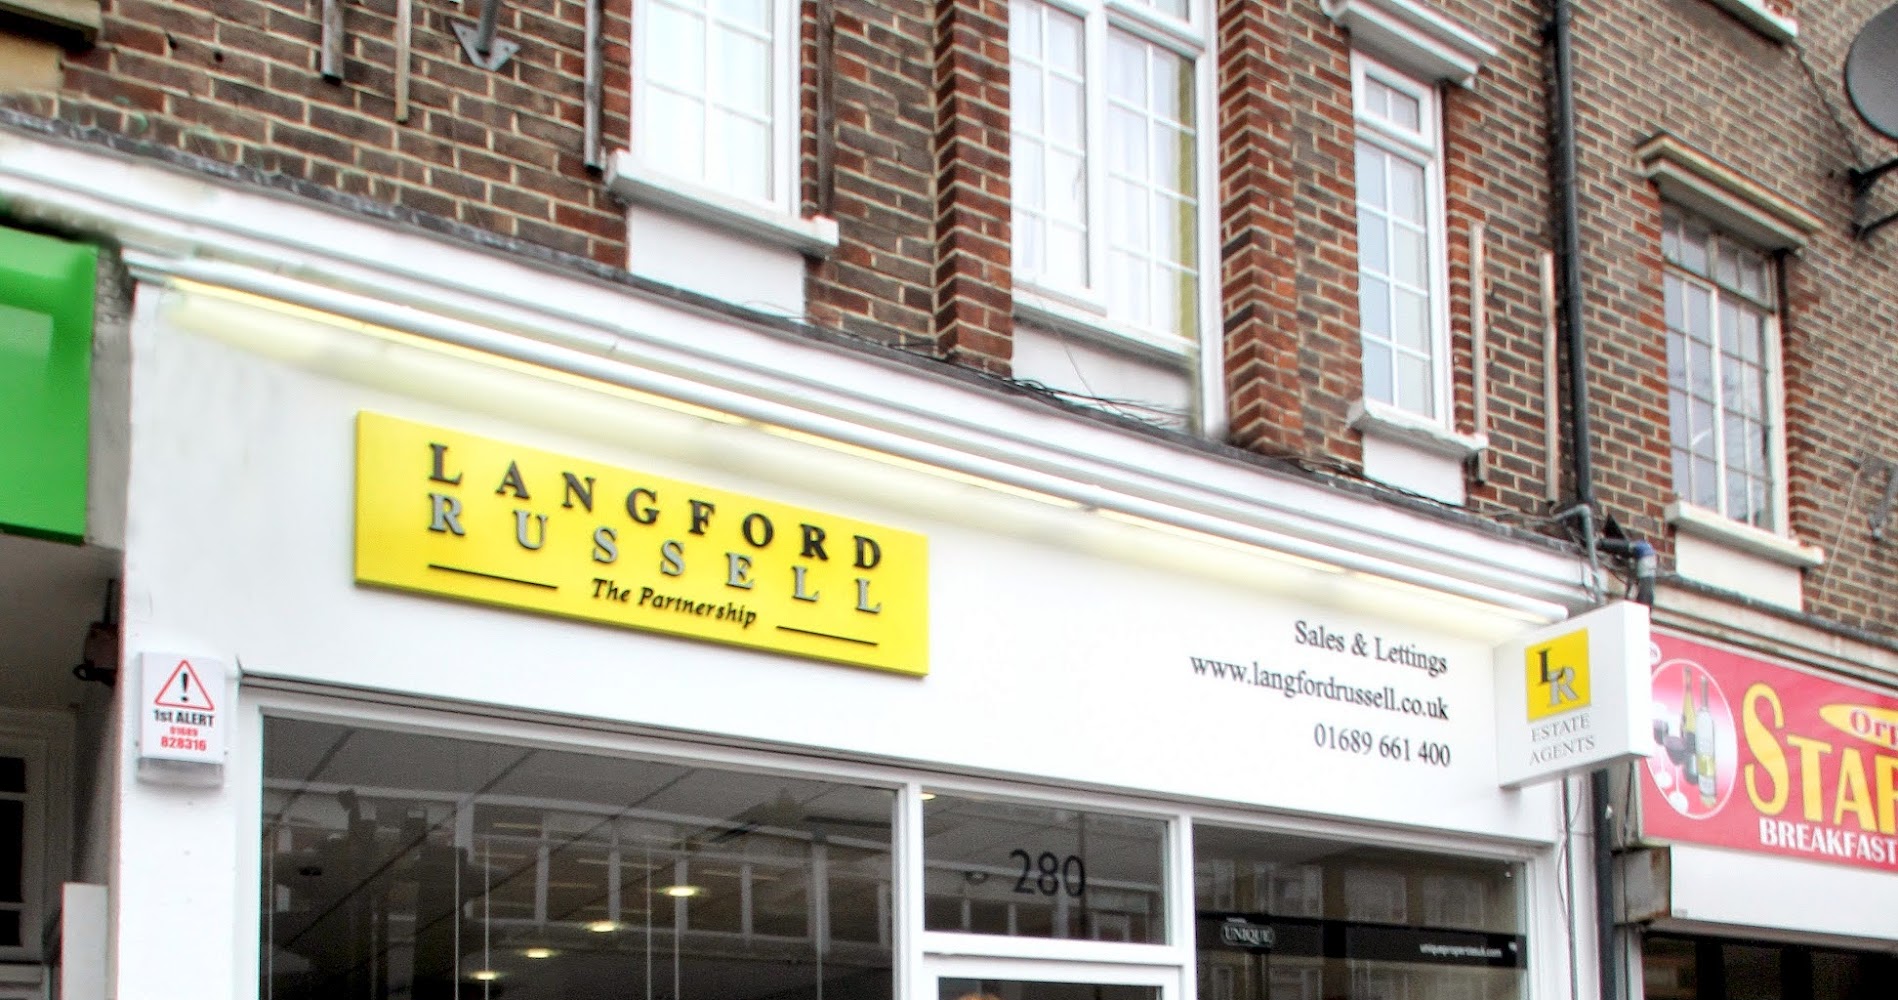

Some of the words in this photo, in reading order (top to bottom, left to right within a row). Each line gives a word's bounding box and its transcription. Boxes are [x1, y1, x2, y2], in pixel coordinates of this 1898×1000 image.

[428, 442, 882, 570] LANGFORD
[428, 493, 882, 615] RUSSELL
[591, 577, 631, 603] The
[638, 586, 758, 629] Partnership
[1293, 620, 1345, 654] Sales
[1351, 632, 1368, 658] &
[1374, 636, 1448, 677] Lettings
[1189, 654, 1450, 721] www.langfordrussell.co.uk
[175, 711, 215, 728] ALERT
[1530, 713, 1591, 743] ESTATE
[1313, 722, 1373, 754] 01689
[1378, 731, 1411, 762] 661
[1417, 736, 1452, 767] 400
[1529, 735, 1597, 766] AGENTS
[1758, 816, 1898, 865] BREAKFAST
[1009, 848, 1086, 897] 280
[1223, 925, 1272, 945] UNIQUE
